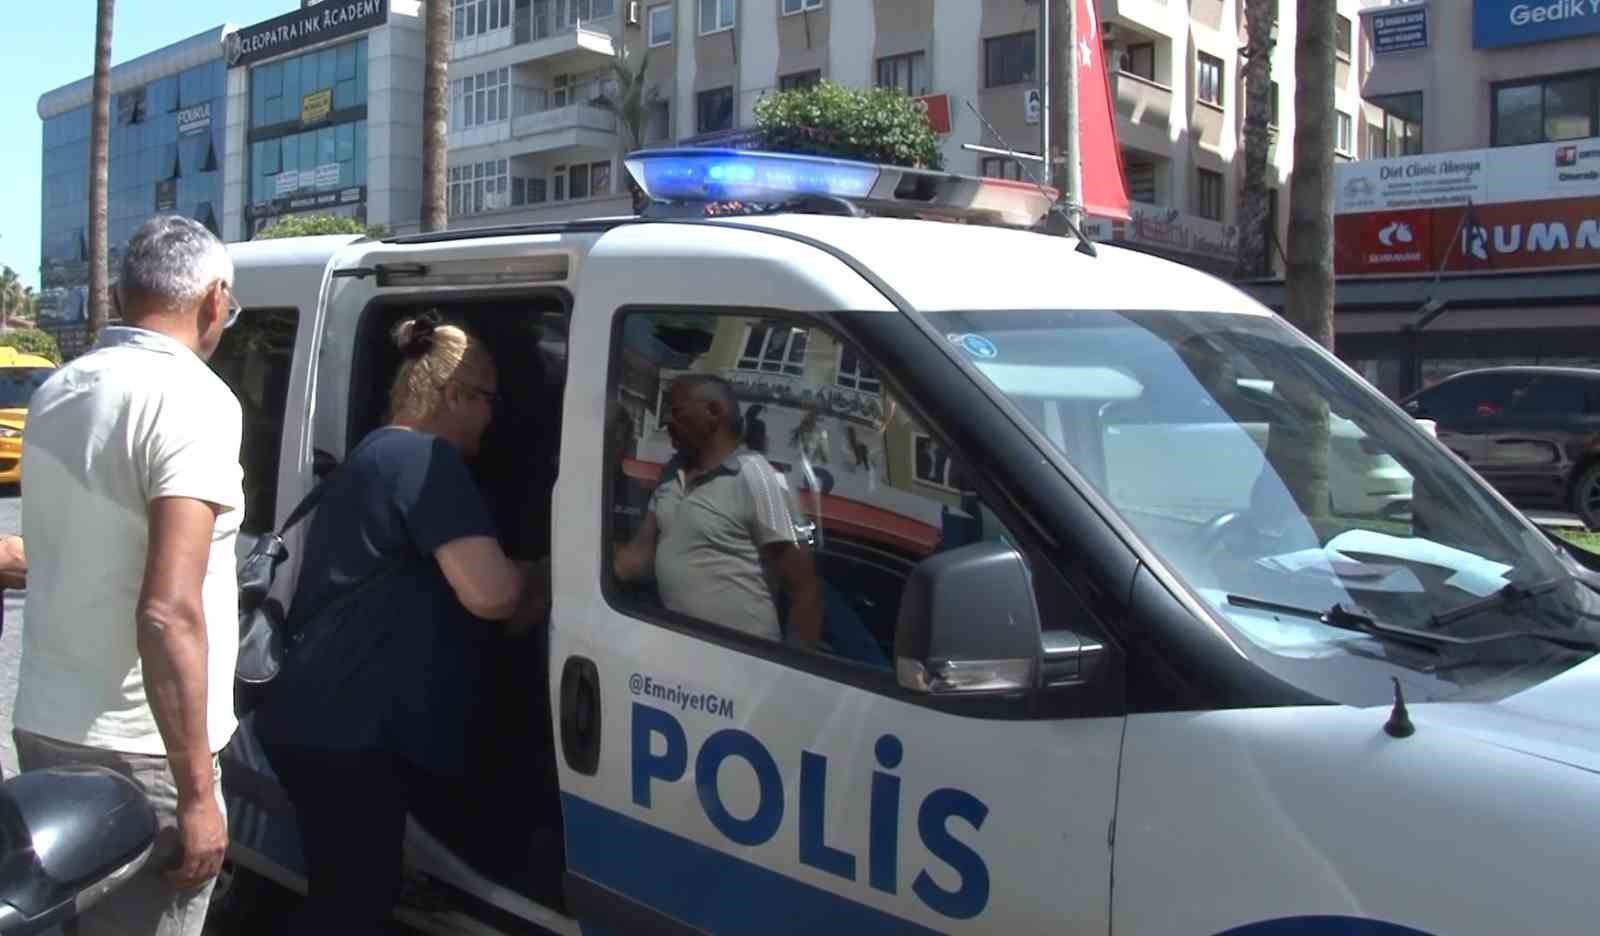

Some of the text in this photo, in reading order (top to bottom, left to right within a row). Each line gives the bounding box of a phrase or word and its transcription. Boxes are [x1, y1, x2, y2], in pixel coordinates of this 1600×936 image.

[242, 0, 380, 53] CLEOPATRA INK ACADEMY
[1509, 0, 1584, 26] Gedik
[1379, 165, 1403, 180] Diet
[1406, 162, 1437, 178] Clinic
[628, 672, 735, 720] @EmniyetGM
